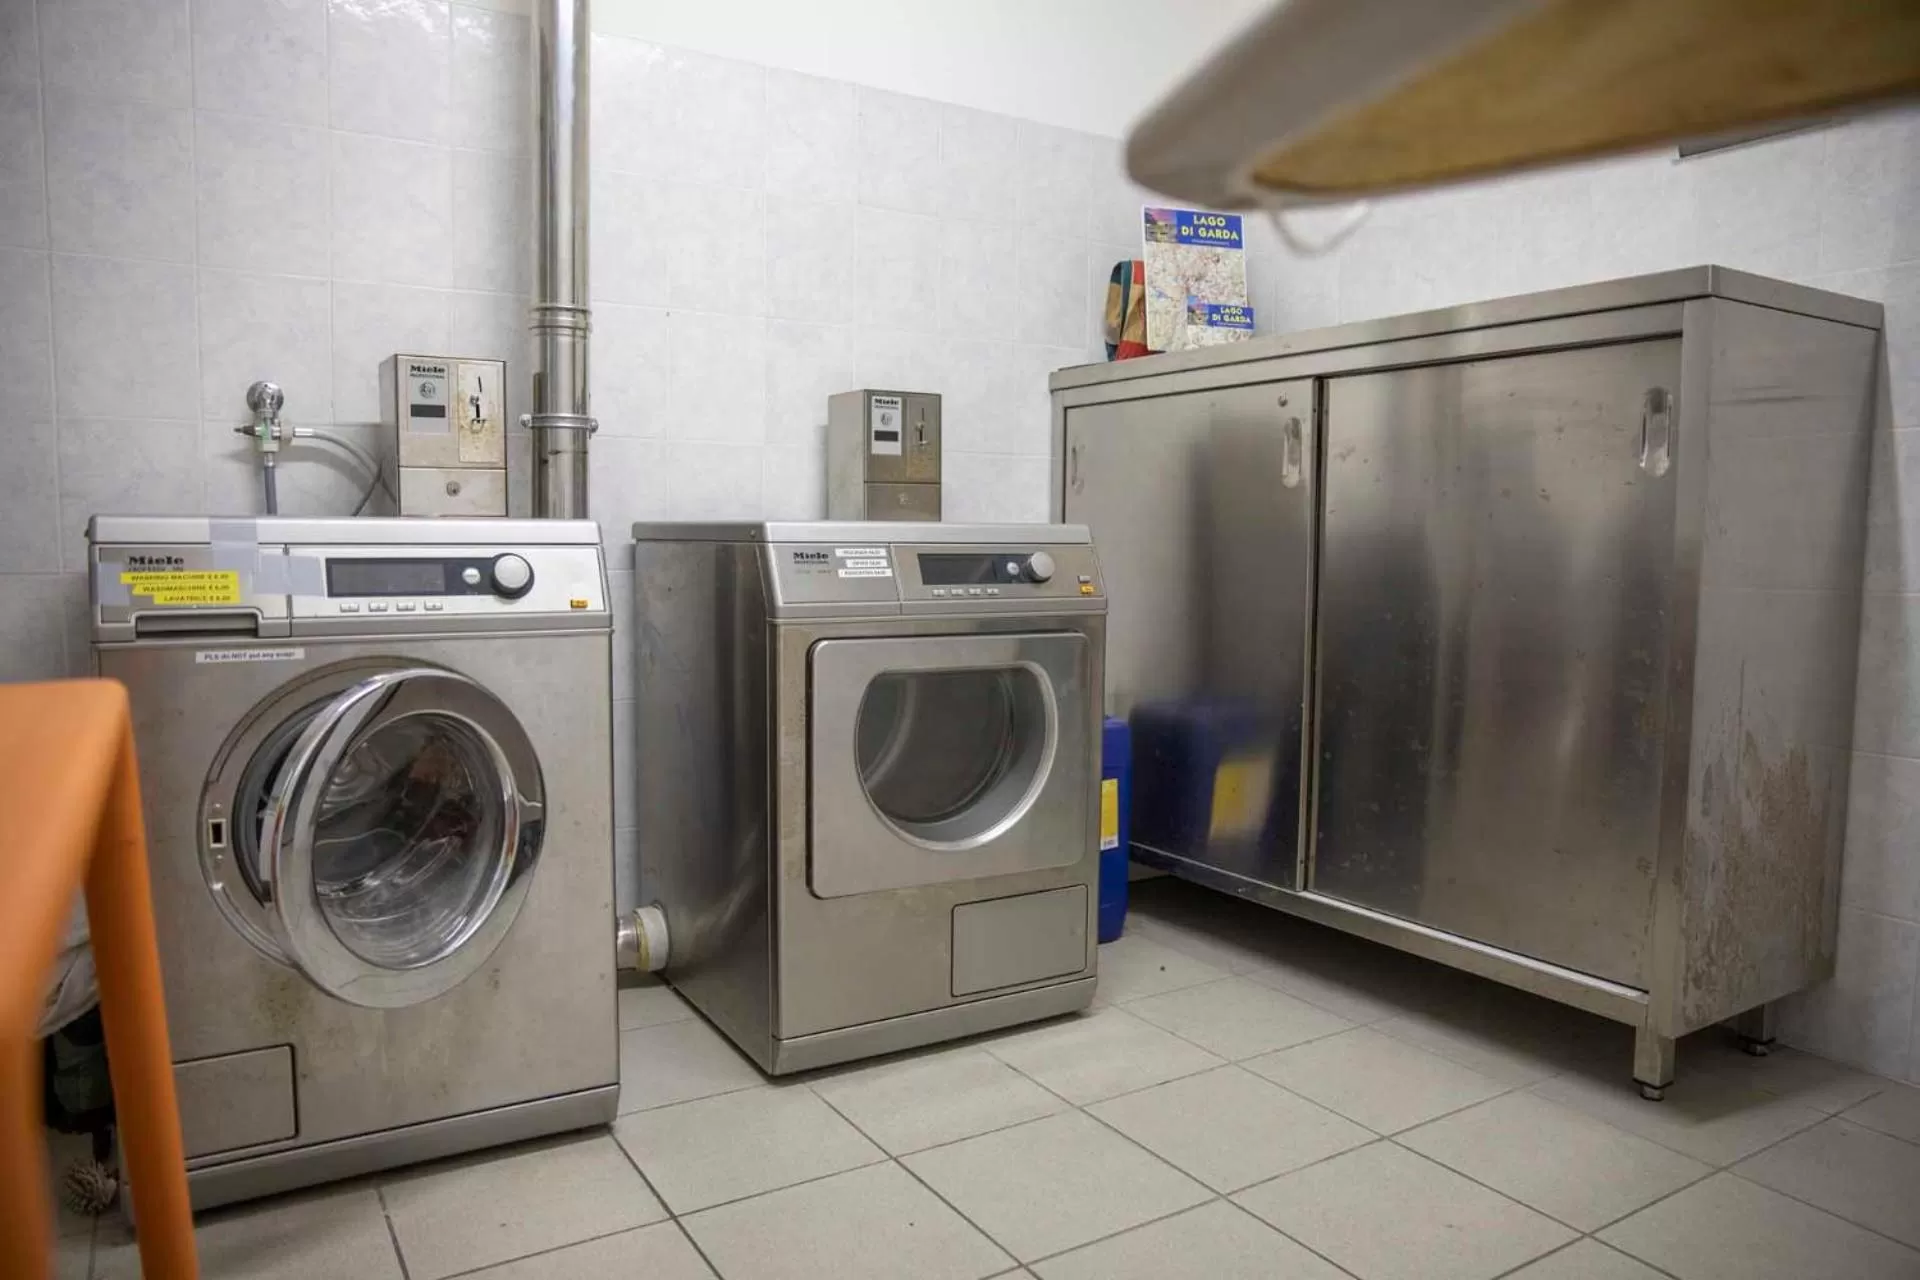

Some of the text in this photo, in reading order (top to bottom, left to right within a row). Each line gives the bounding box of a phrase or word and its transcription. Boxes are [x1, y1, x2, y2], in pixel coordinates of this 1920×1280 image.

[1193, 214, 1226, 227] LAGO
[1181, 225, 1240, 241] DI GARDA
[1220, 306, 1243, 315] LAGO
[1212, 313, 1221, 321] DI
[1223, 314, 1252, 324] GARDA
[410, 364, 445, 374] Miele
[128, 556, 185, 565] Miele
[792, 551, 829, 560] Miele
